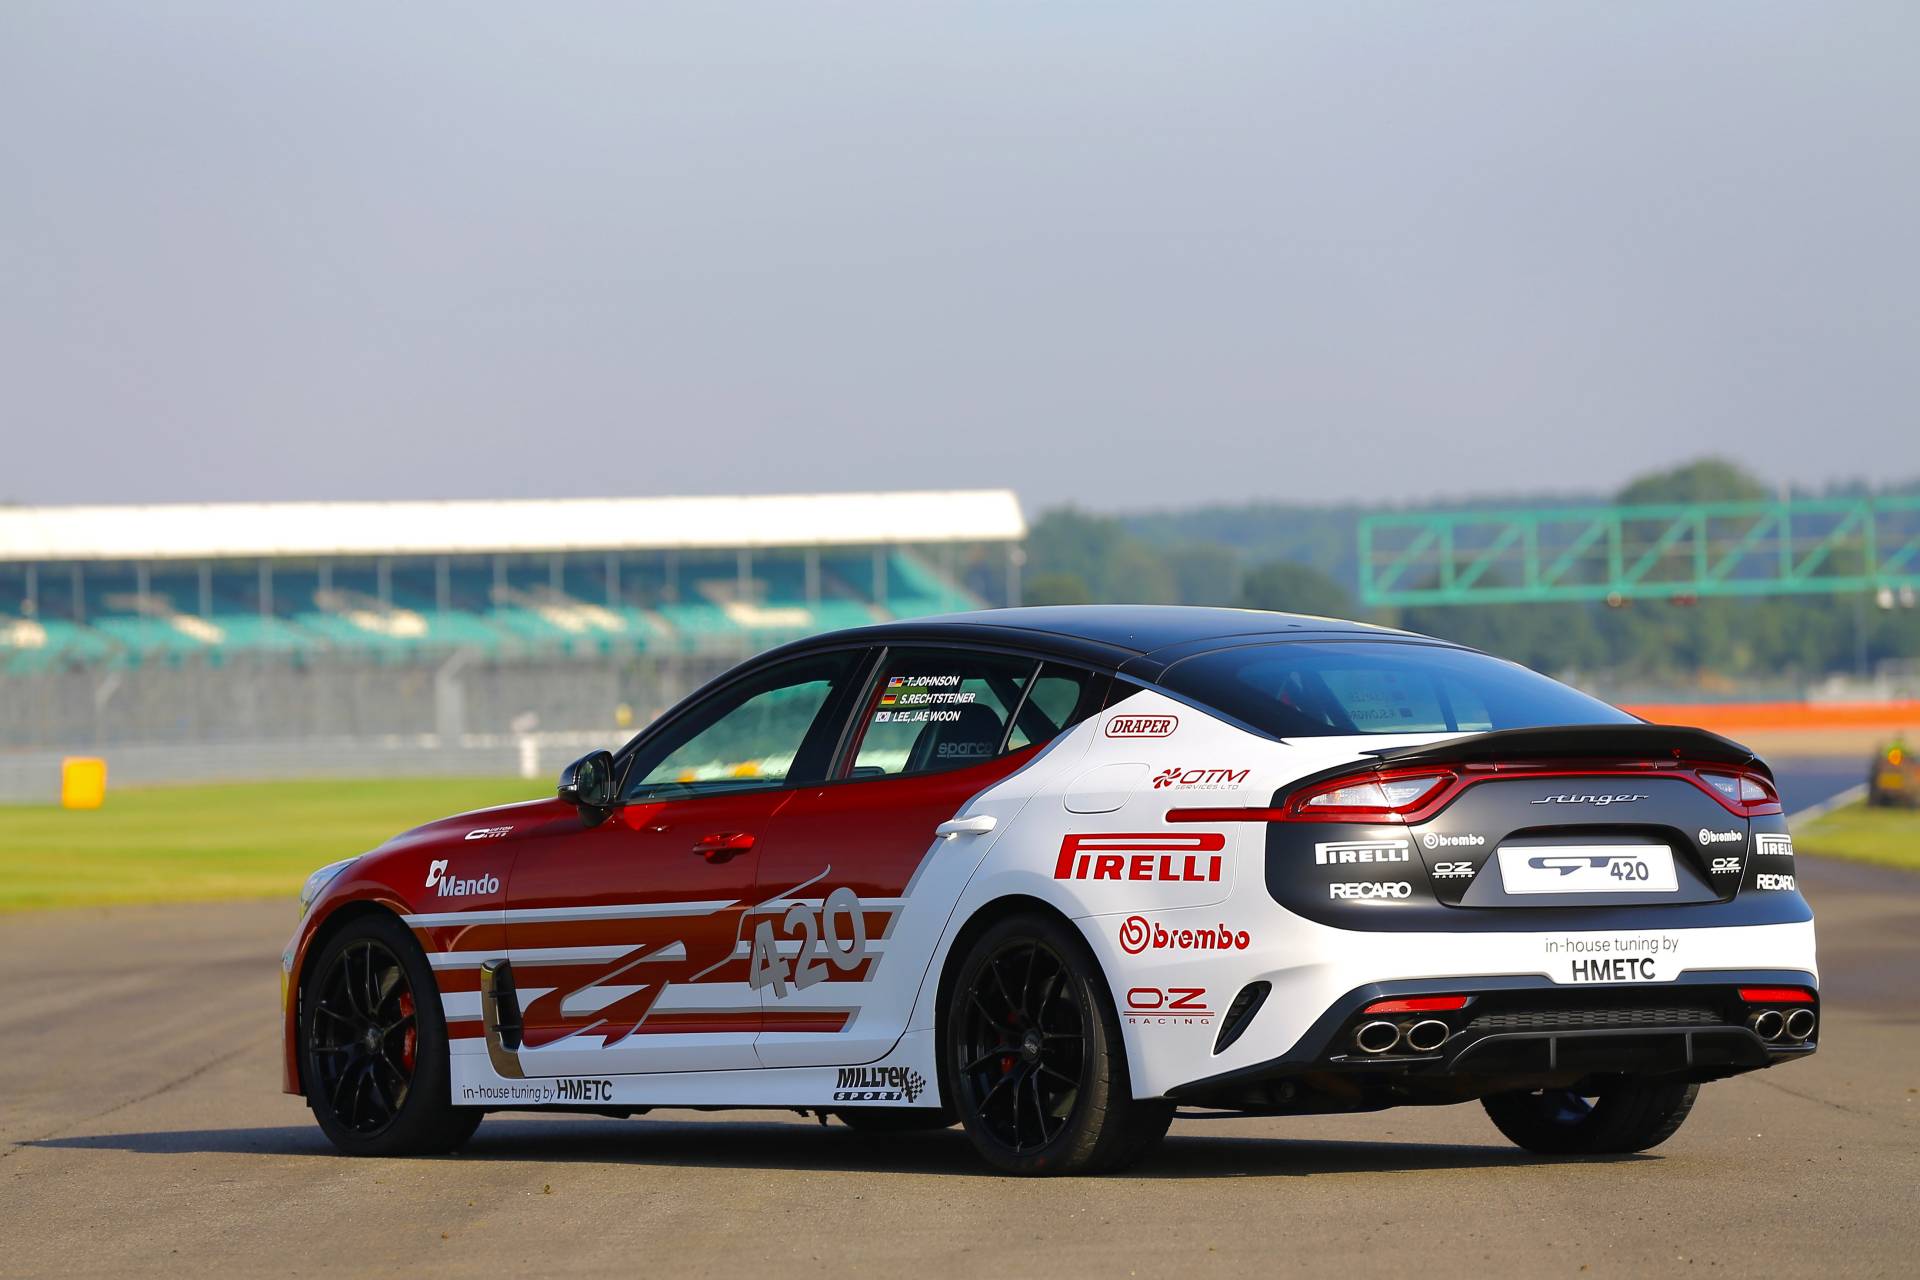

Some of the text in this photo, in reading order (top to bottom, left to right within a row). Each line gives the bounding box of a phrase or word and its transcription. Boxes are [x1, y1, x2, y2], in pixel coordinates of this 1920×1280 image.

[907, 676, 960, 687] T.JOHNSON
[900, 693, 975, 704] S.RECHTSTEINER
[911, 711, 929, 721] JAE
[929, 711, 961, 721] WOON
[1111, 719, 1171, 733] DRAPER
[1180, 769, 1250, 784] OTM
[1054, 833, 1225, 881] PIRELLI
[1315, 839, 1409, 865] PIRELLI
[1611, 861, 1649, 881] 420
[438, 873, 499, 896] Mando
[1329, 881, 1412, 899] RECARO
[750, 887, 865, 999] 420
[1545, 936, 1679, 953] in-house tuning by
[1572, 957, 1656, 981] HMETC
[463, 1080, 613, 1102] in-house tuning by HMETC
[837, 1092, 900, 1100] SPORT
